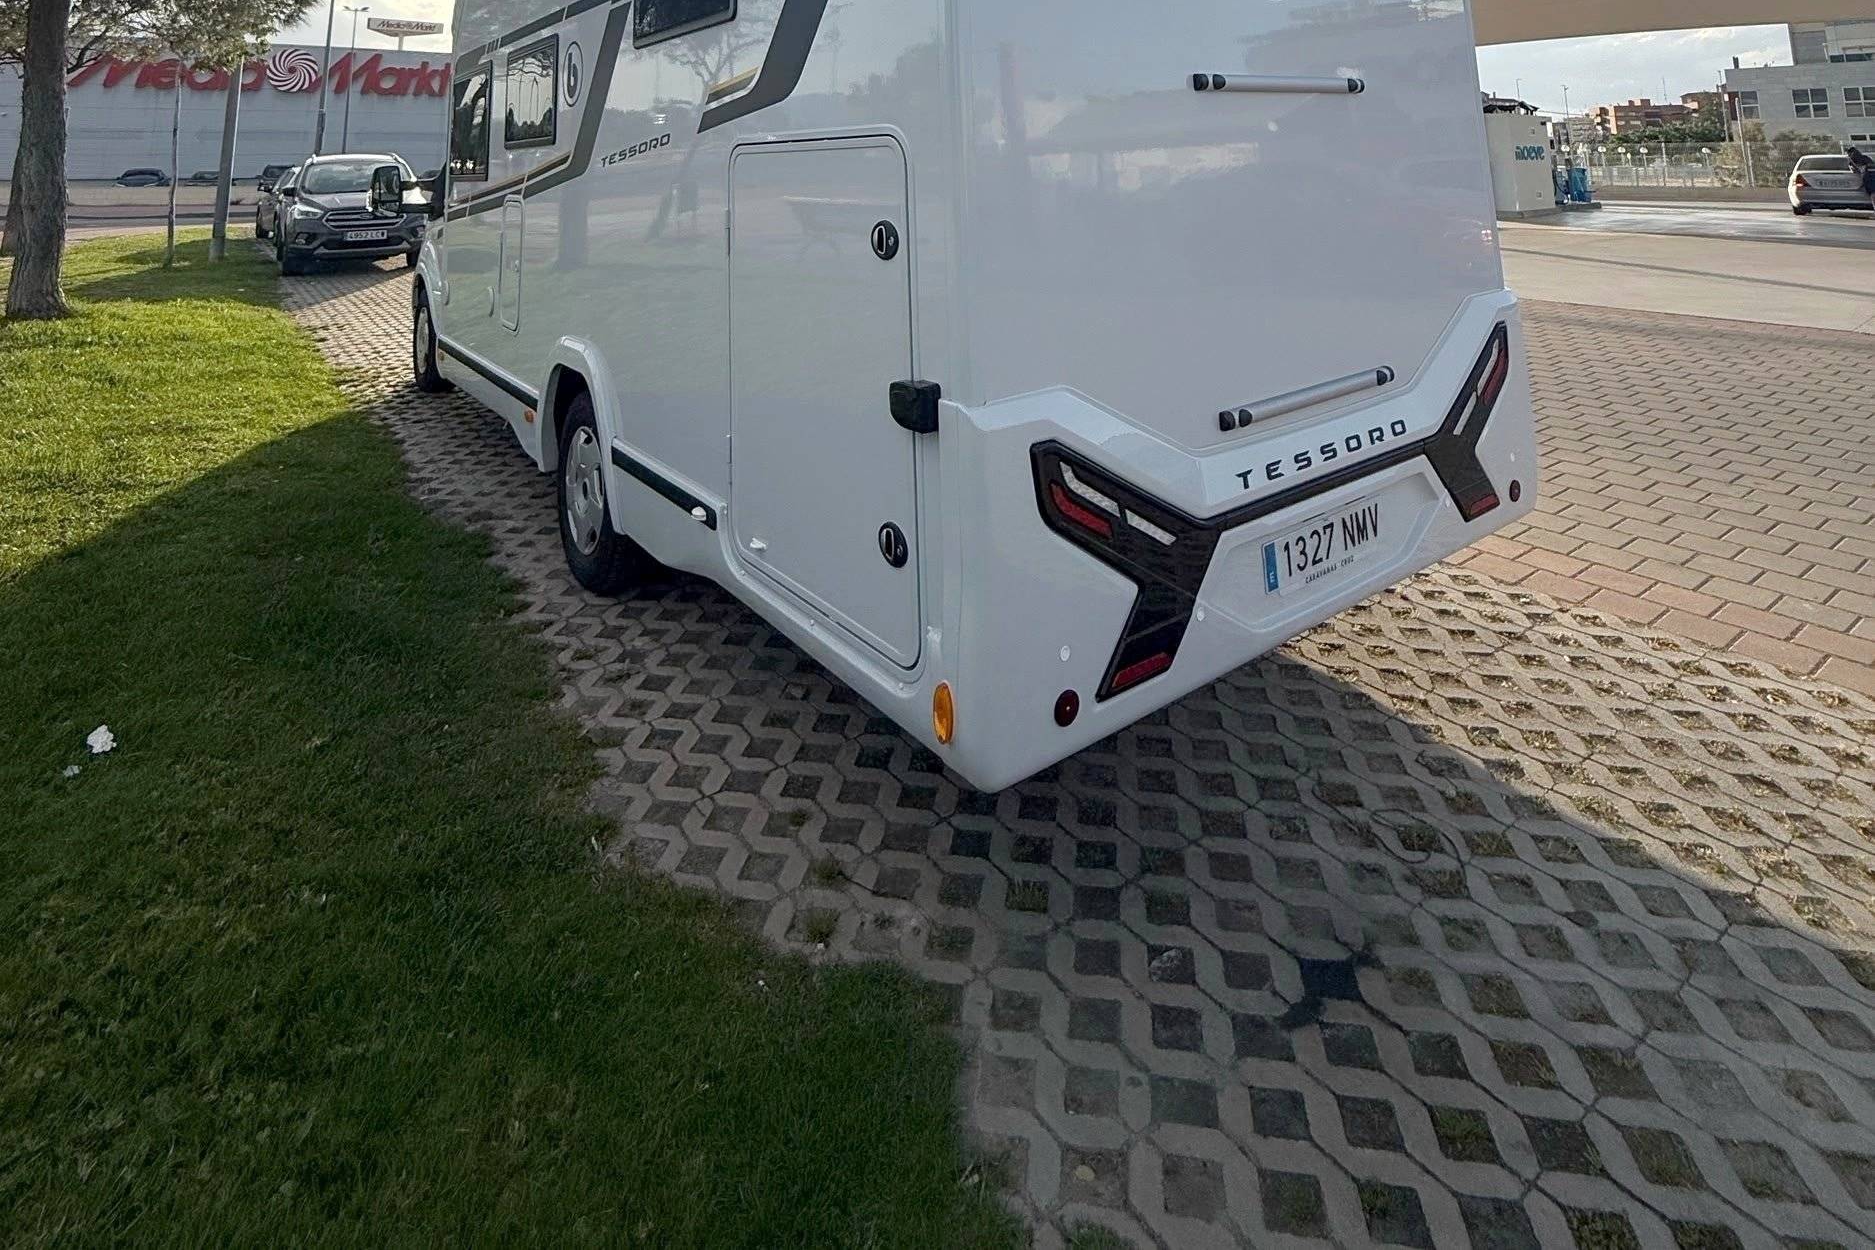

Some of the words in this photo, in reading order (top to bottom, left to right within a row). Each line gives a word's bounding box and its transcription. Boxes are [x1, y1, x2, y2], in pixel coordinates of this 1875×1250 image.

[600, 133, 671, 168] TESSORO
[1235, 419, 1407, 490] TESSORO
[1283, 521, 1335, 578] 1327
[1341, 503, 1378, 551] NMV
